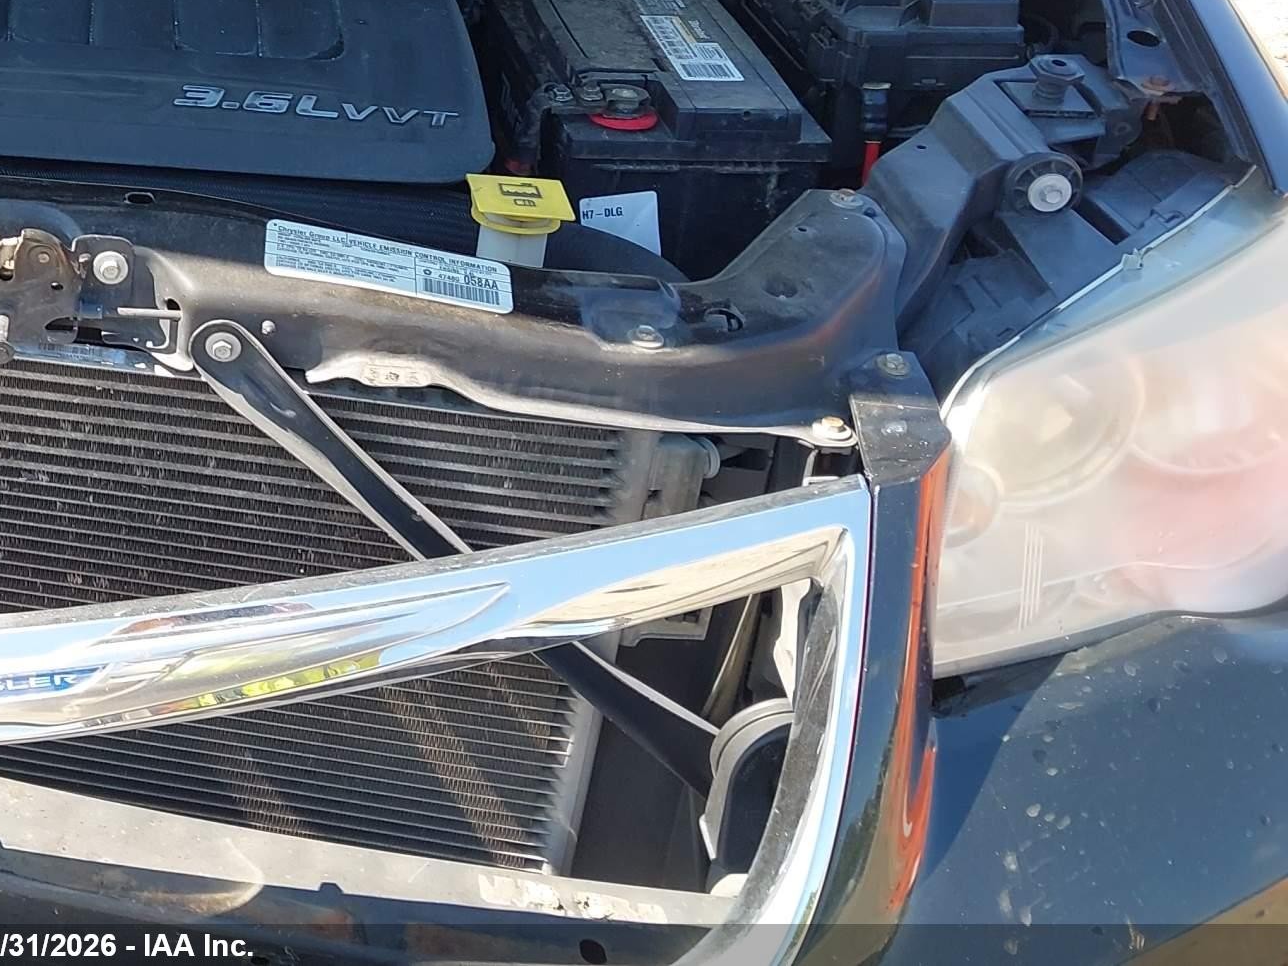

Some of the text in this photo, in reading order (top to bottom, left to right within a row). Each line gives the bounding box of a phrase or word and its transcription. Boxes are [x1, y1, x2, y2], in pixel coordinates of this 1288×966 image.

[277, 225, 307, 238] Chrysler
[308, 230, 331, 242] Group
[332, 234, 346, 245] LLC
[348, 238, 378, 251] VEHICLE
[379, 244, 413, 257] EMISSION
[414, 251, 447, 264] CONTROL
[448, 258, 498, 273] INFORMATION
[463, 274, 499, 291] 058AA
